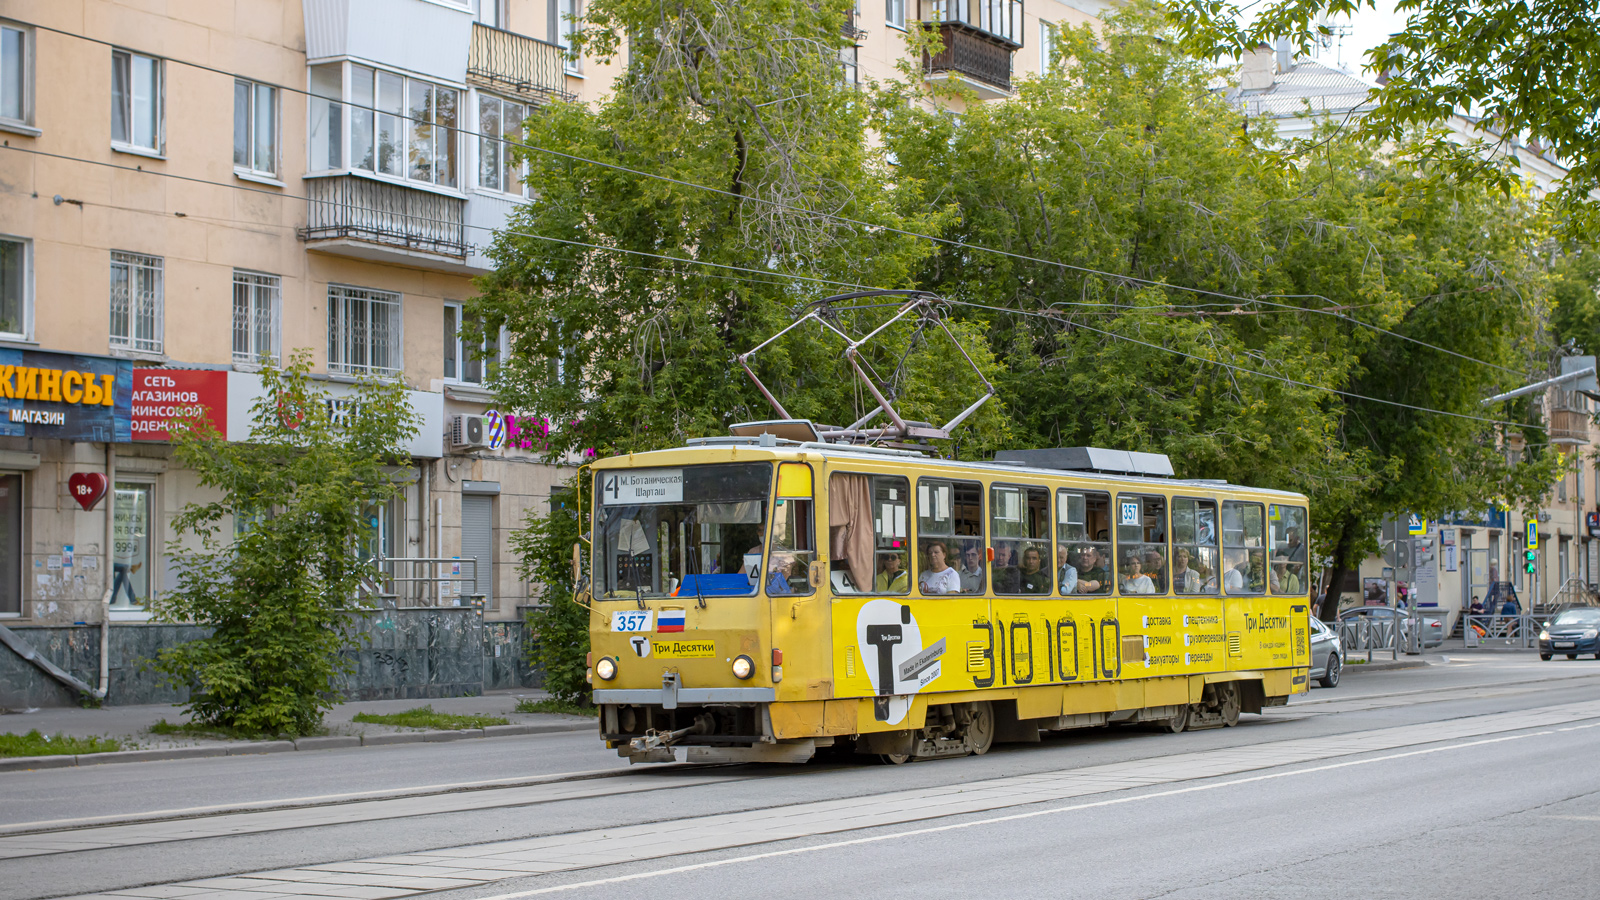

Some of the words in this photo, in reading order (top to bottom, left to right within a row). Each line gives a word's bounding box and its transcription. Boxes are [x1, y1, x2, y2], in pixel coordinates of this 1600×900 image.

[144, 376, 176, 387] СЕТЬ
[11, 408, 65, 426] МАГАЗИН
[630, 475, 683, 486] Ботаническая
[76, 484, 93, 495] 18+
[605, 475, 619, 499] 4
[635, 487, 666, 498] Шарташ
[1124, 504, 1137, 520] 357
[617, 615, 647, 631] 357
[1146, 616, 1171, 628] доставка
[1185, 615, 1218, 626] спецтехника
[1244, 613, 1257, 633] Три
[1259, 612, 1287, 633] Десятки
[1146, 636, 1171, 648] грузчики
[1187, 633, 1227, 646] грузоперевозки
[653, 643, 669, 654] Три
[672, 642, 715, 655] Десятки
[903, 664, 915, 675] Made
[919, 647, 944, 666] Ekaterinburg
[1147, 654, 1179, 666] эвакуаторы
[1187, 653, 1213, 664] переезды
[920, 675, 931, 687] Since
